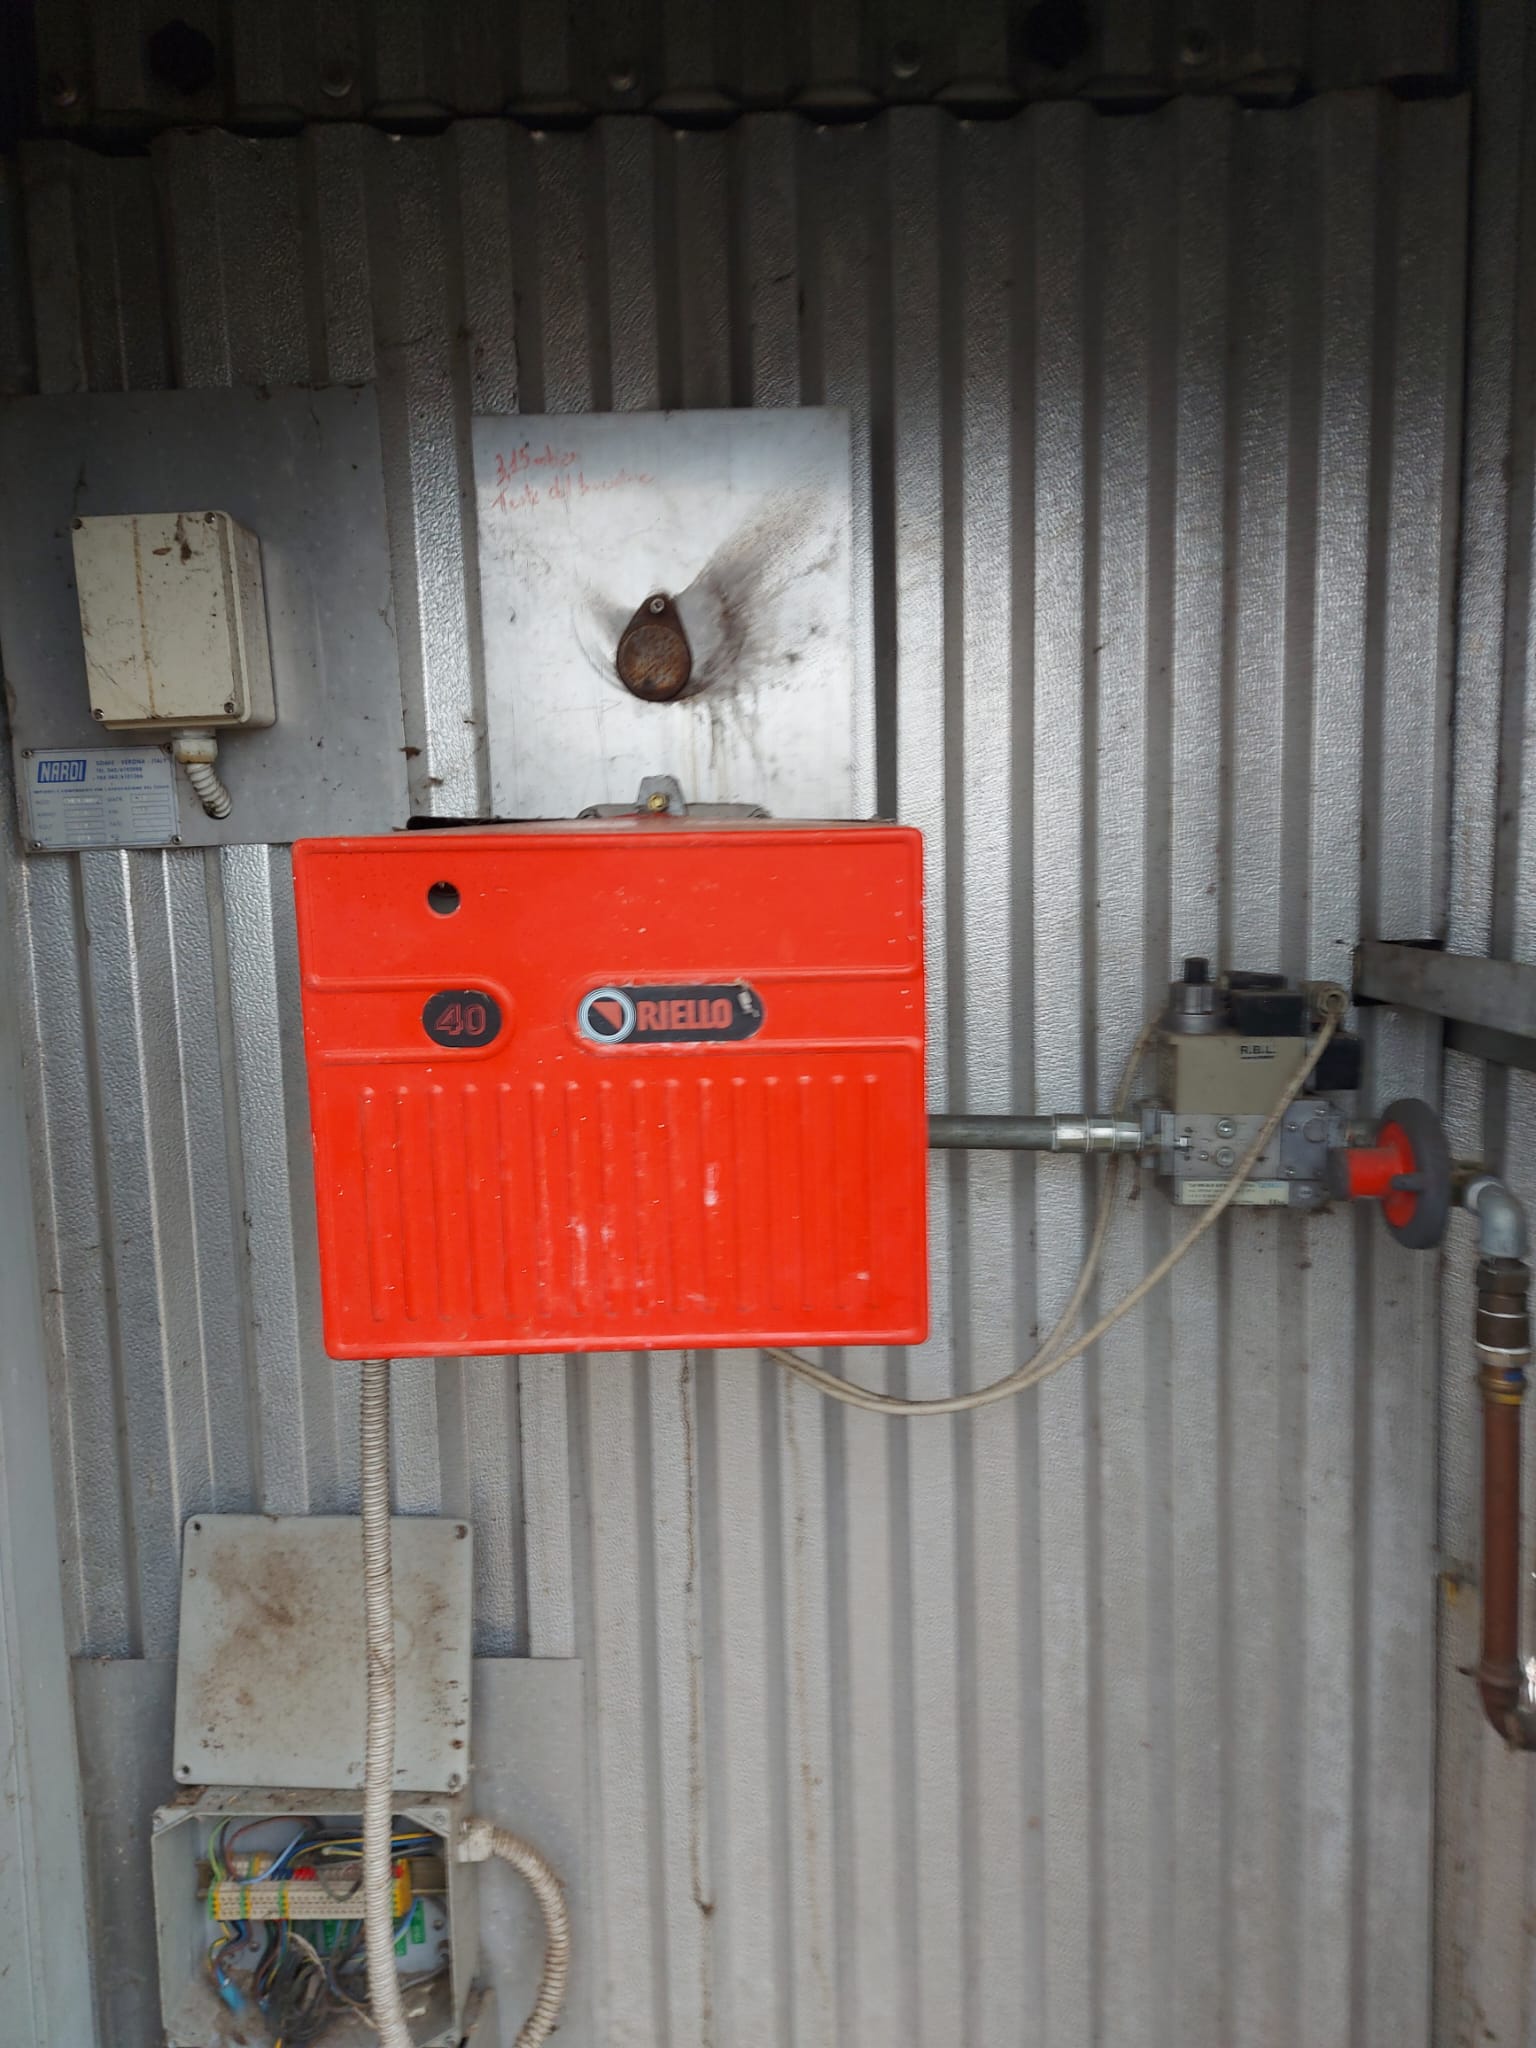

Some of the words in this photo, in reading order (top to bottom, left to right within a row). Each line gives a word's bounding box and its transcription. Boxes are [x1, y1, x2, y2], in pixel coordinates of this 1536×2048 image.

[41, 760, 83, 782] NARDI
[435, 1004, 487, 1035] 40
[637, 998, 734, 1032] RIELLO
